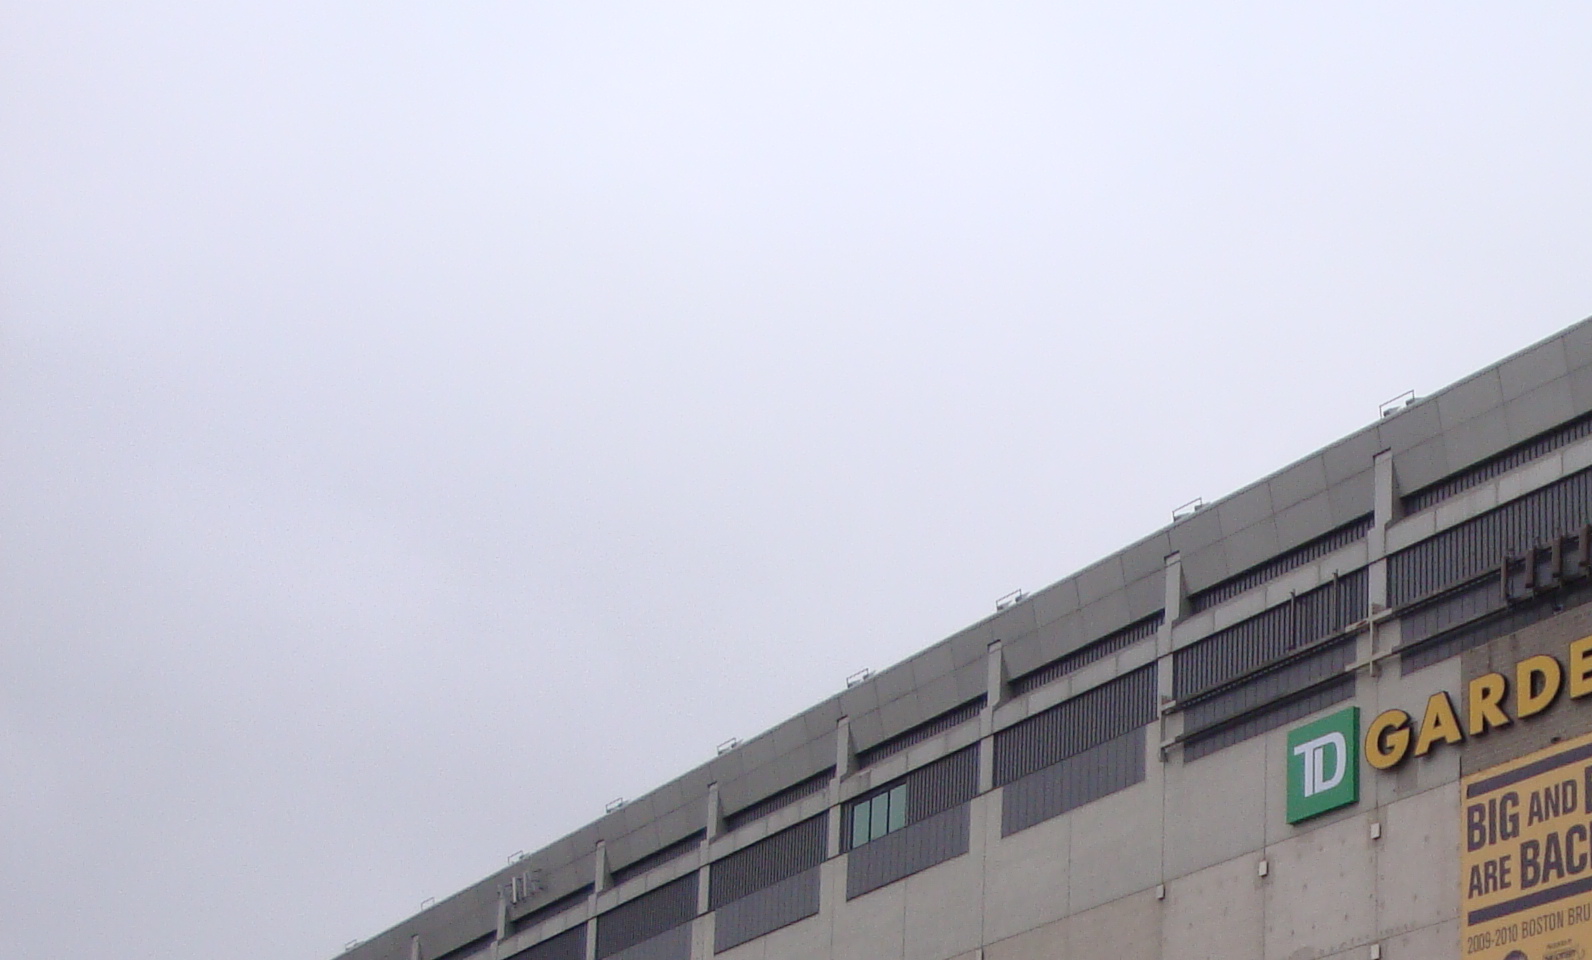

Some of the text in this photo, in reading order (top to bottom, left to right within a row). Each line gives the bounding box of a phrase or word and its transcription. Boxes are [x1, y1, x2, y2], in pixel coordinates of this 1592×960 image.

[1294, 731, 1347, 798] TD
[1466, 790, 1520, 852] BIG
[1527, 778, 1577, 827] AND
[1467, 854, 1512, 899] ARE
[1467, 926, 1519, 955] 2009-2010
[1521, 913, 1565, 940] BOSTON
